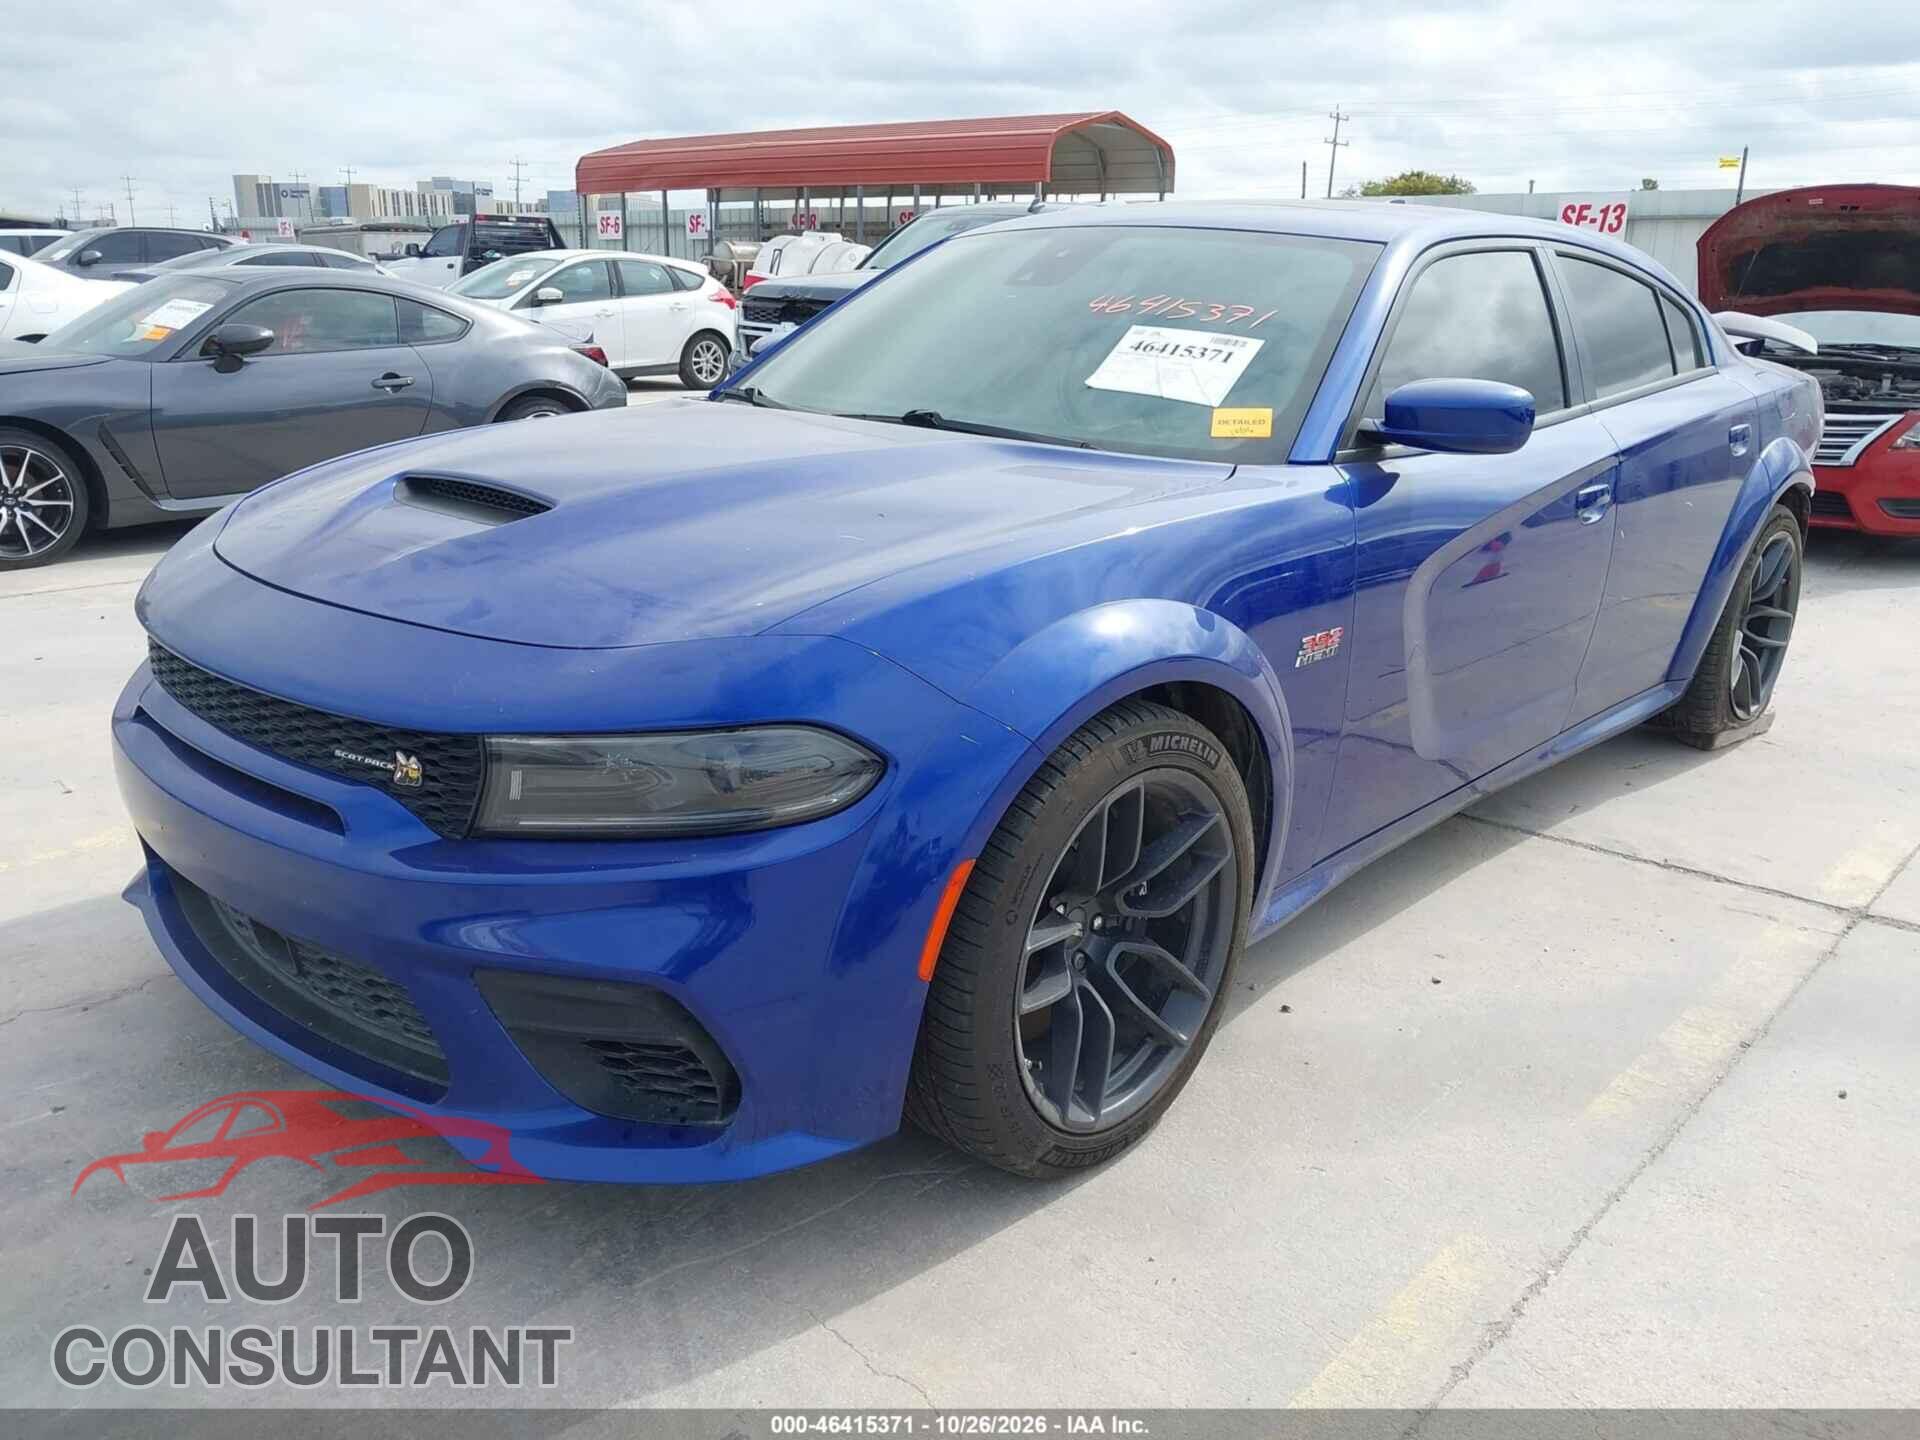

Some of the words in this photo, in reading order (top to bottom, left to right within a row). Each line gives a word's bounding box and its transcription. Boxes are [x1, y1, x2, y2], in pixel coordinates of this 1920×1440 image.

[600, 216, 620, 234] SF-6
[689, 214, 707, 233] SF-
[1562, 203, 1626, 233] SF-13
[1129, 339, 1234, 363] 46415371
[1217, 418, 1267, 426] DETAILED
[333, 748, 364, 762] SCAT
[364, 757, 397, 771] PACK
[1149, 734, 1219, 766] MICHELIN
